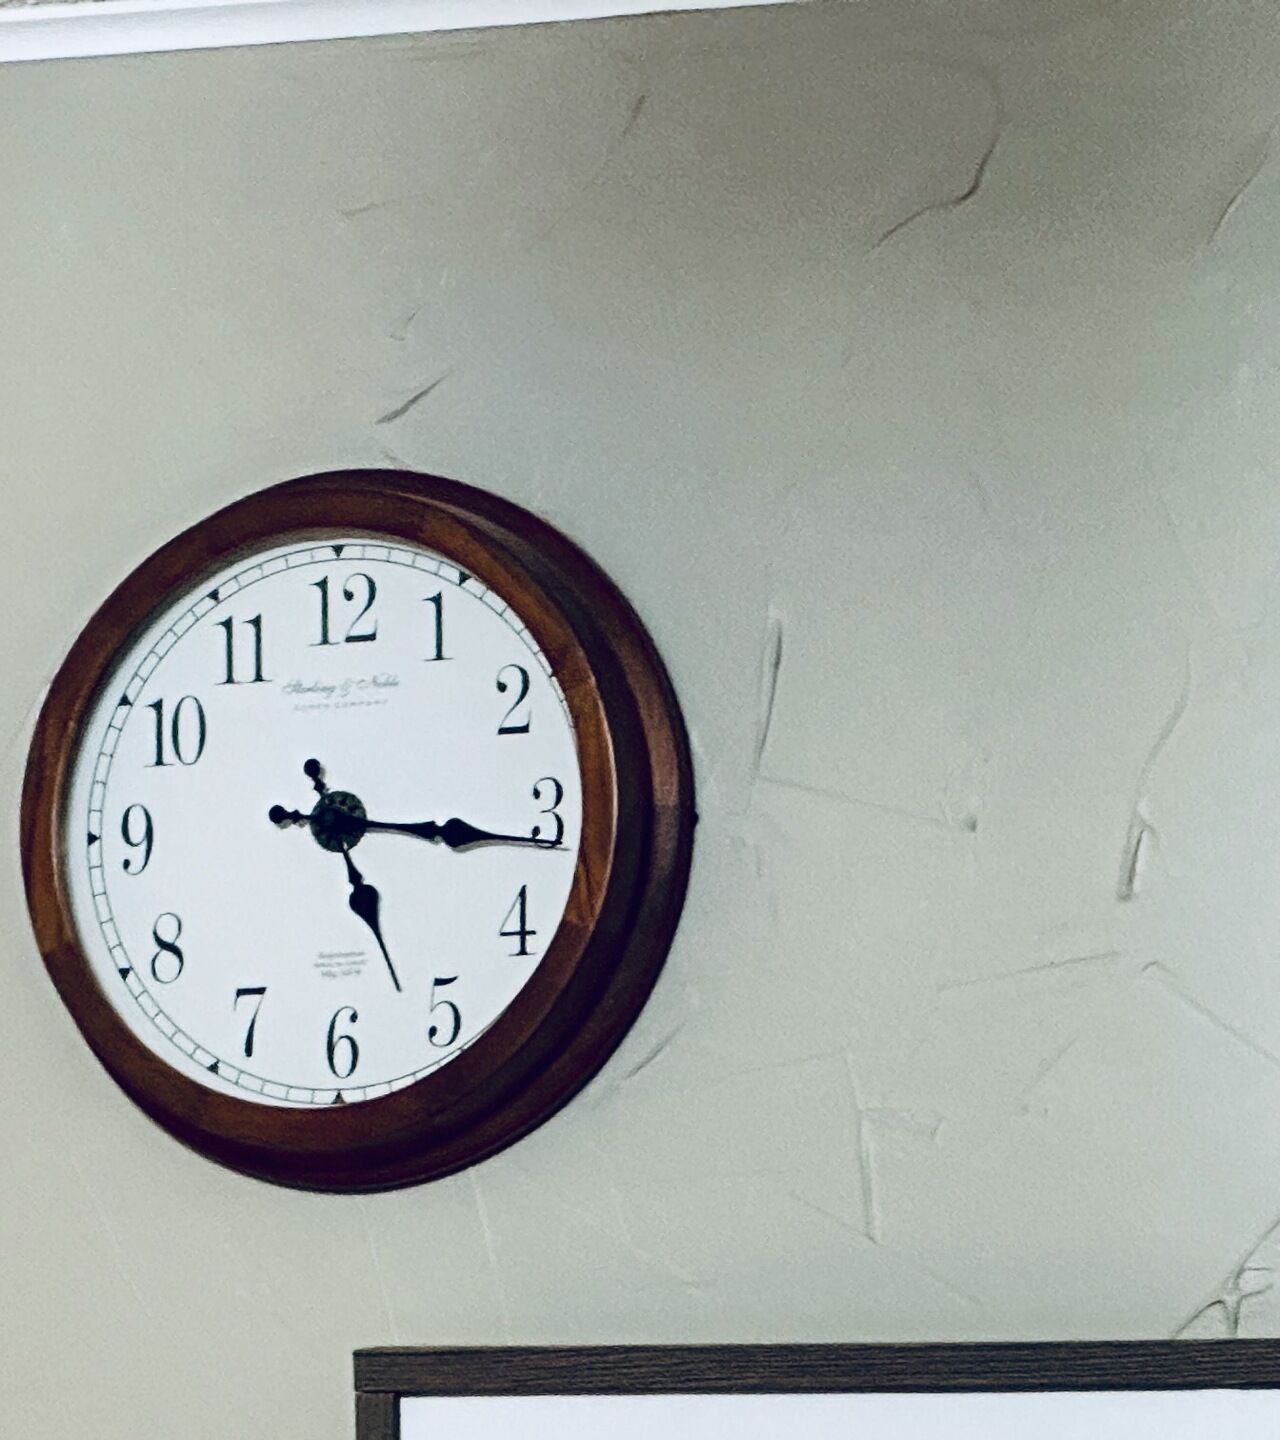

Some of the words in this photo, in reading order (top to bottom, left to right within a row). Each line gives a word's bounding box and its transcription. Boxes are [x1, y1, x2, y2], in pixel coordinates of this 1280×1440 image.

[309, 572, 378, 648] 12
[422, 590, 453, 662] 1
[214, 613, 272, 686] 11
[143, 695, 207, 768] 10
[494, 663, 532, 736] 2
[120, 803, 155, 876] 9
[529, 776, 565, 850] 3
[150, 912, 185, 985] 8
[498, 884, 538, 957] 4
[232, 986, 269, 1059] 7
[325, 1005, 361, 1080] 6
[427, 975, 463, 1048] 5
